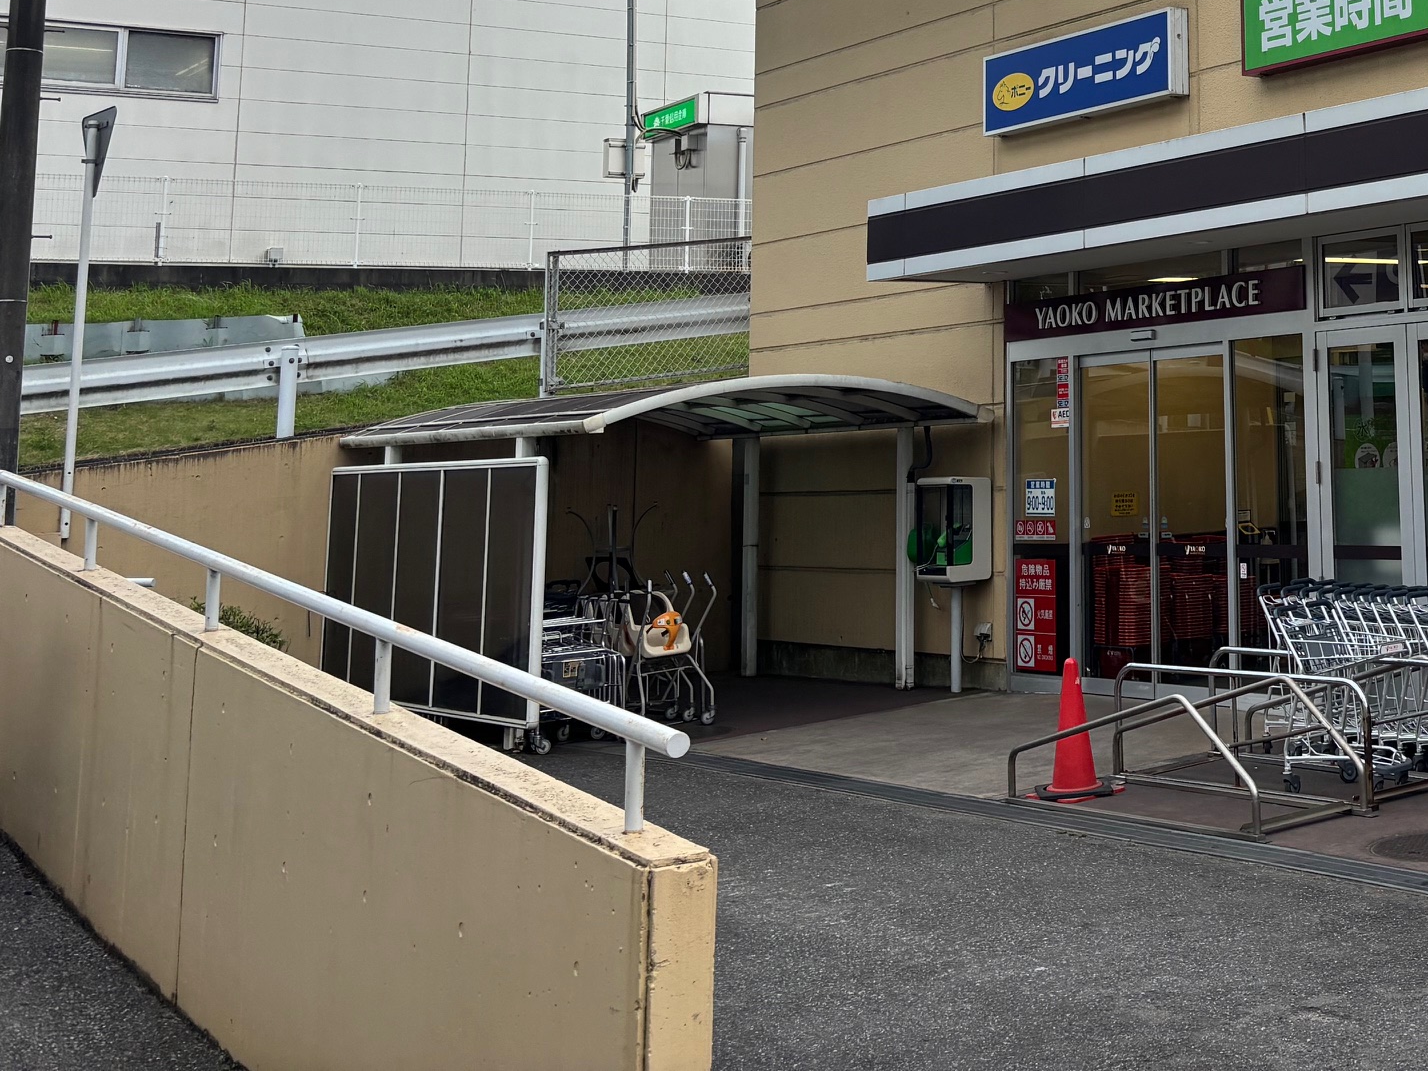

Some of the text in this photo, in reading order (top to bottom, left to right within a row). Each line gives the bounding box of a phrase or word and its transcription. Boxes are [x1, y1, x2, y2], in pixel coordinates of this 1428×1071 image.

[1038, 36, 1161, 99] クリーニング
[1035, 279, 1261, 329] YAOKO MARKETPLACE
[1019, 578, 1052, 590] 持込み厳禁
[1021, 564, 1050, 576] 危険物品
